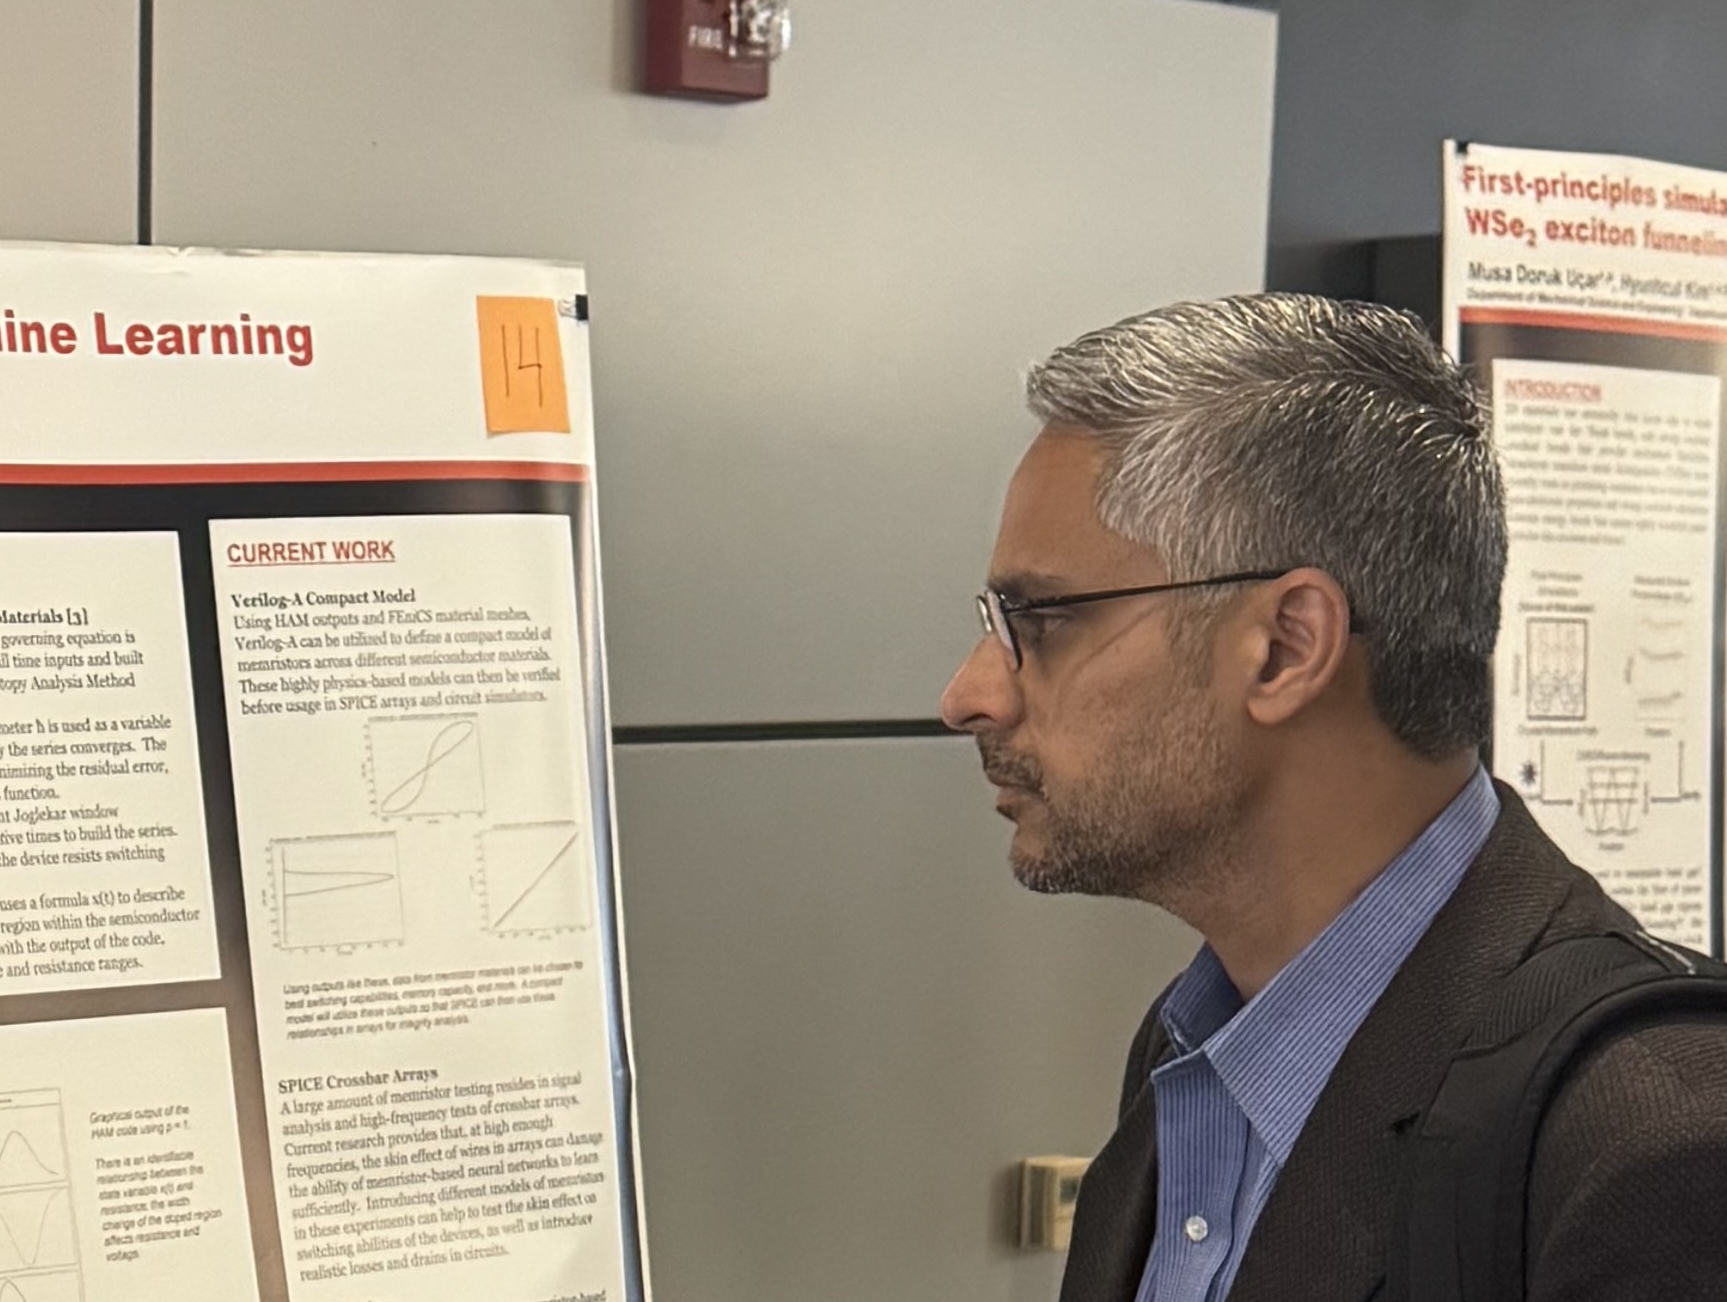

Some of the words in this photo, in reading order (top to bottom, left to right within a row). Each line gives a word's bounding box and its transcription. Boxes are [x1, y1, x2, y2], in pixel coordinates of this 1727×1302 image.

[1462, 166, 1657, 208] First-principles
[1545, 217, 1636, 248] exciton
[93, 311, 313, 366] Learning
[501, 324, 543, 408] 14
[227, 541, 326, 564] CURRENT
[333, 540, 395, 560] WORK
[230, 592, 303, 609] Verilog-A
[305, 591, 369, 608] Compact
[372, 588, 416, 603] Model
[277, 1076, 323, 1094] SPICE
[326, 1071, 389, 1089] Crossbar
[392, 1068, 438, 1083] Arrays
